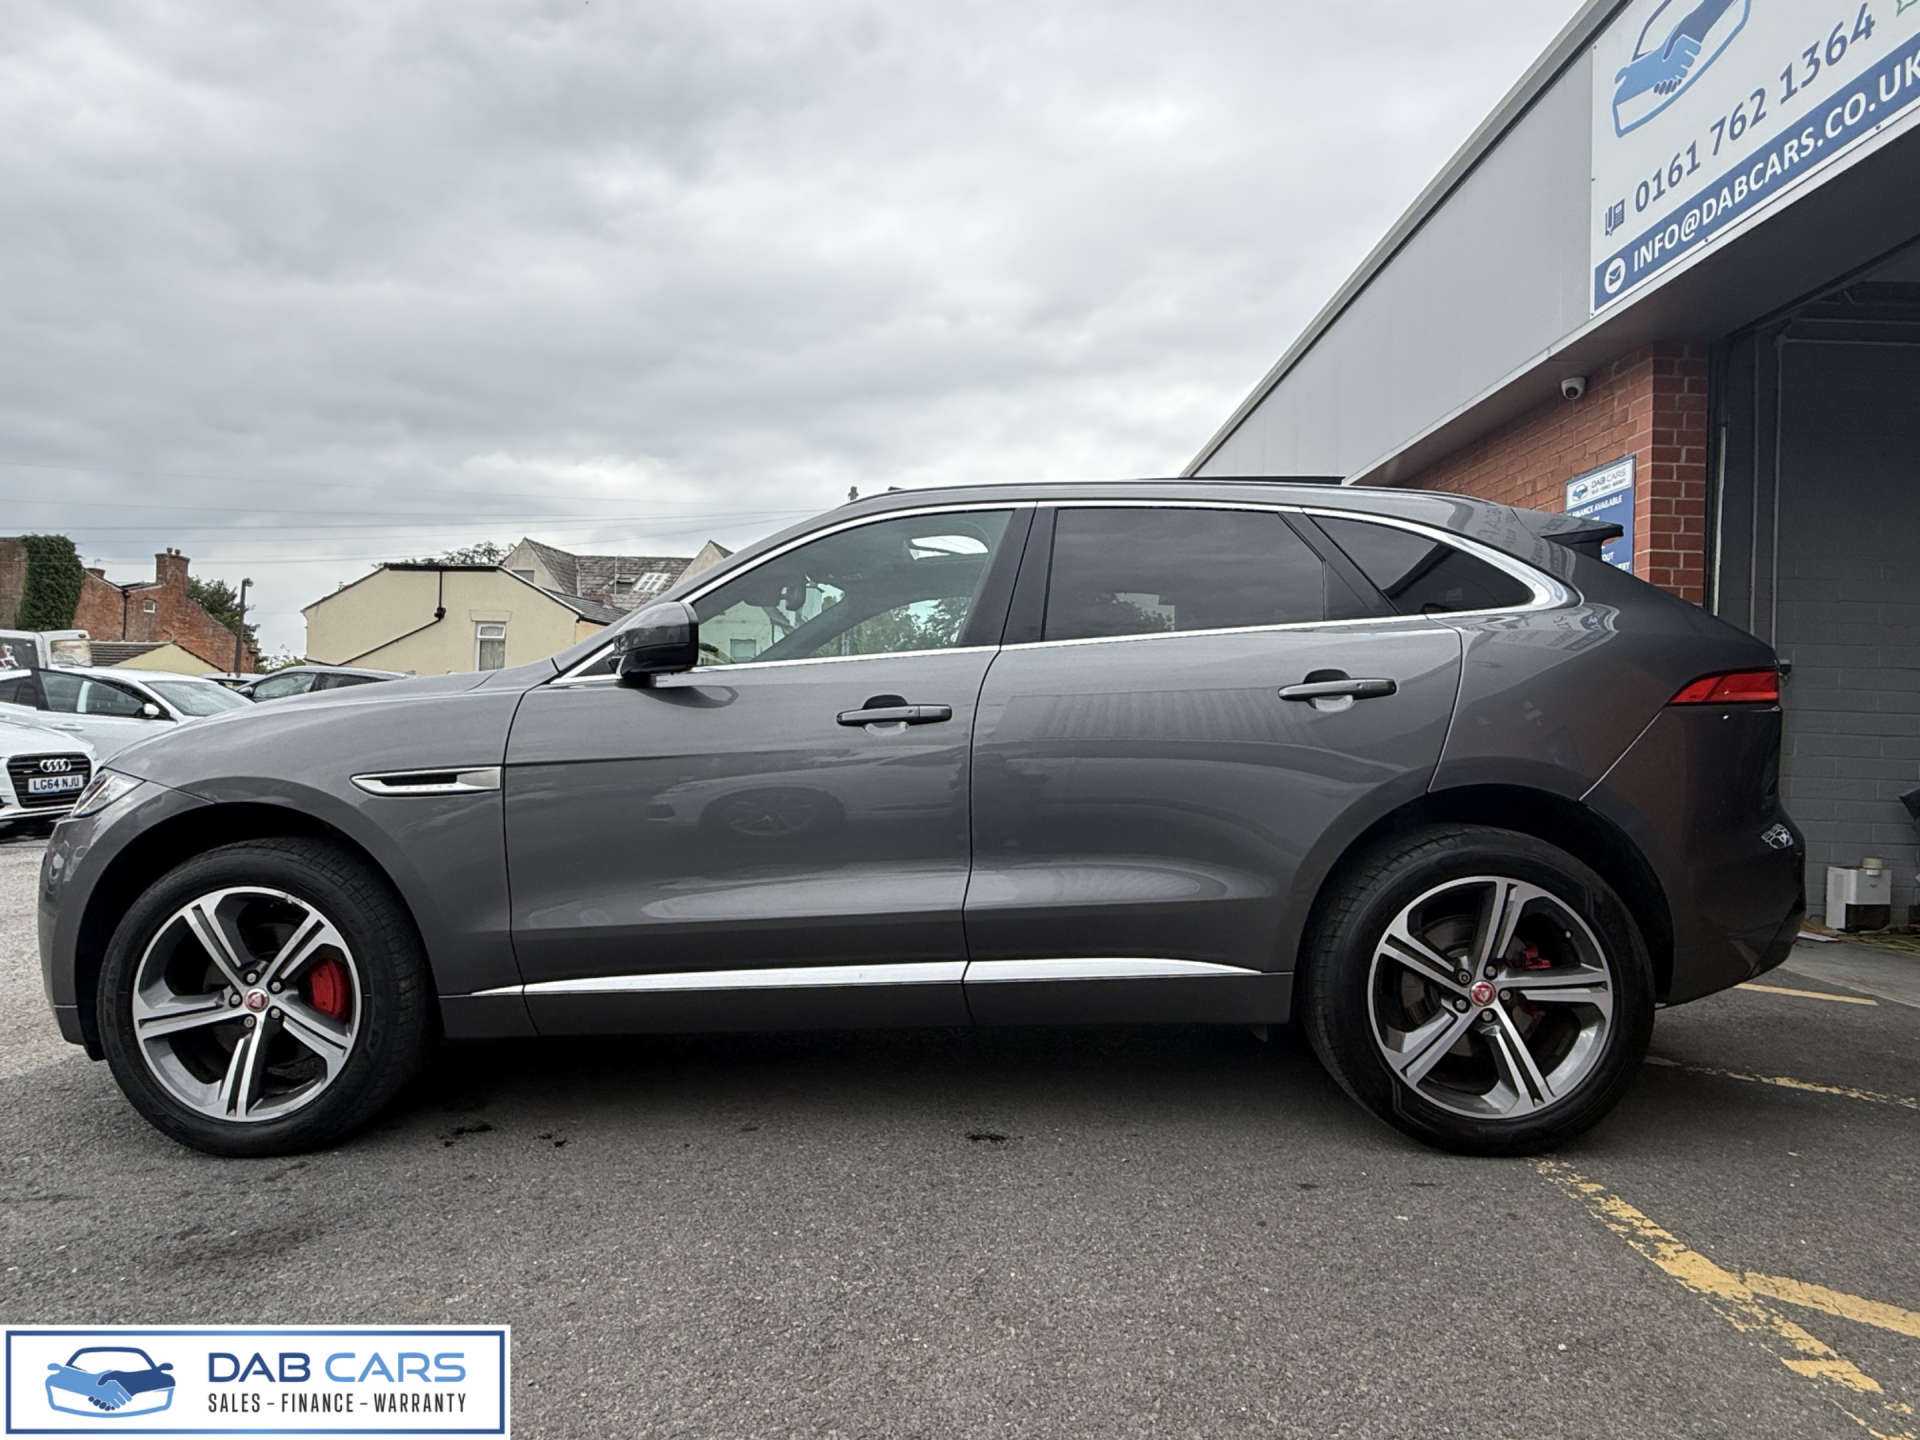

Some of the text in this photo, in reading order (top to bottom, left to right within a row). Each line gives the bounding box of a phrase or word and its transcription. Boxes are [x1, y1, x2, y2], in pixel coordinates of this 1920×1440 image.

[1633, 49, 1920, 272] INFO@DABCARS.CO.UK
[1635, 2, 1875, 213] 0161 762 1364
